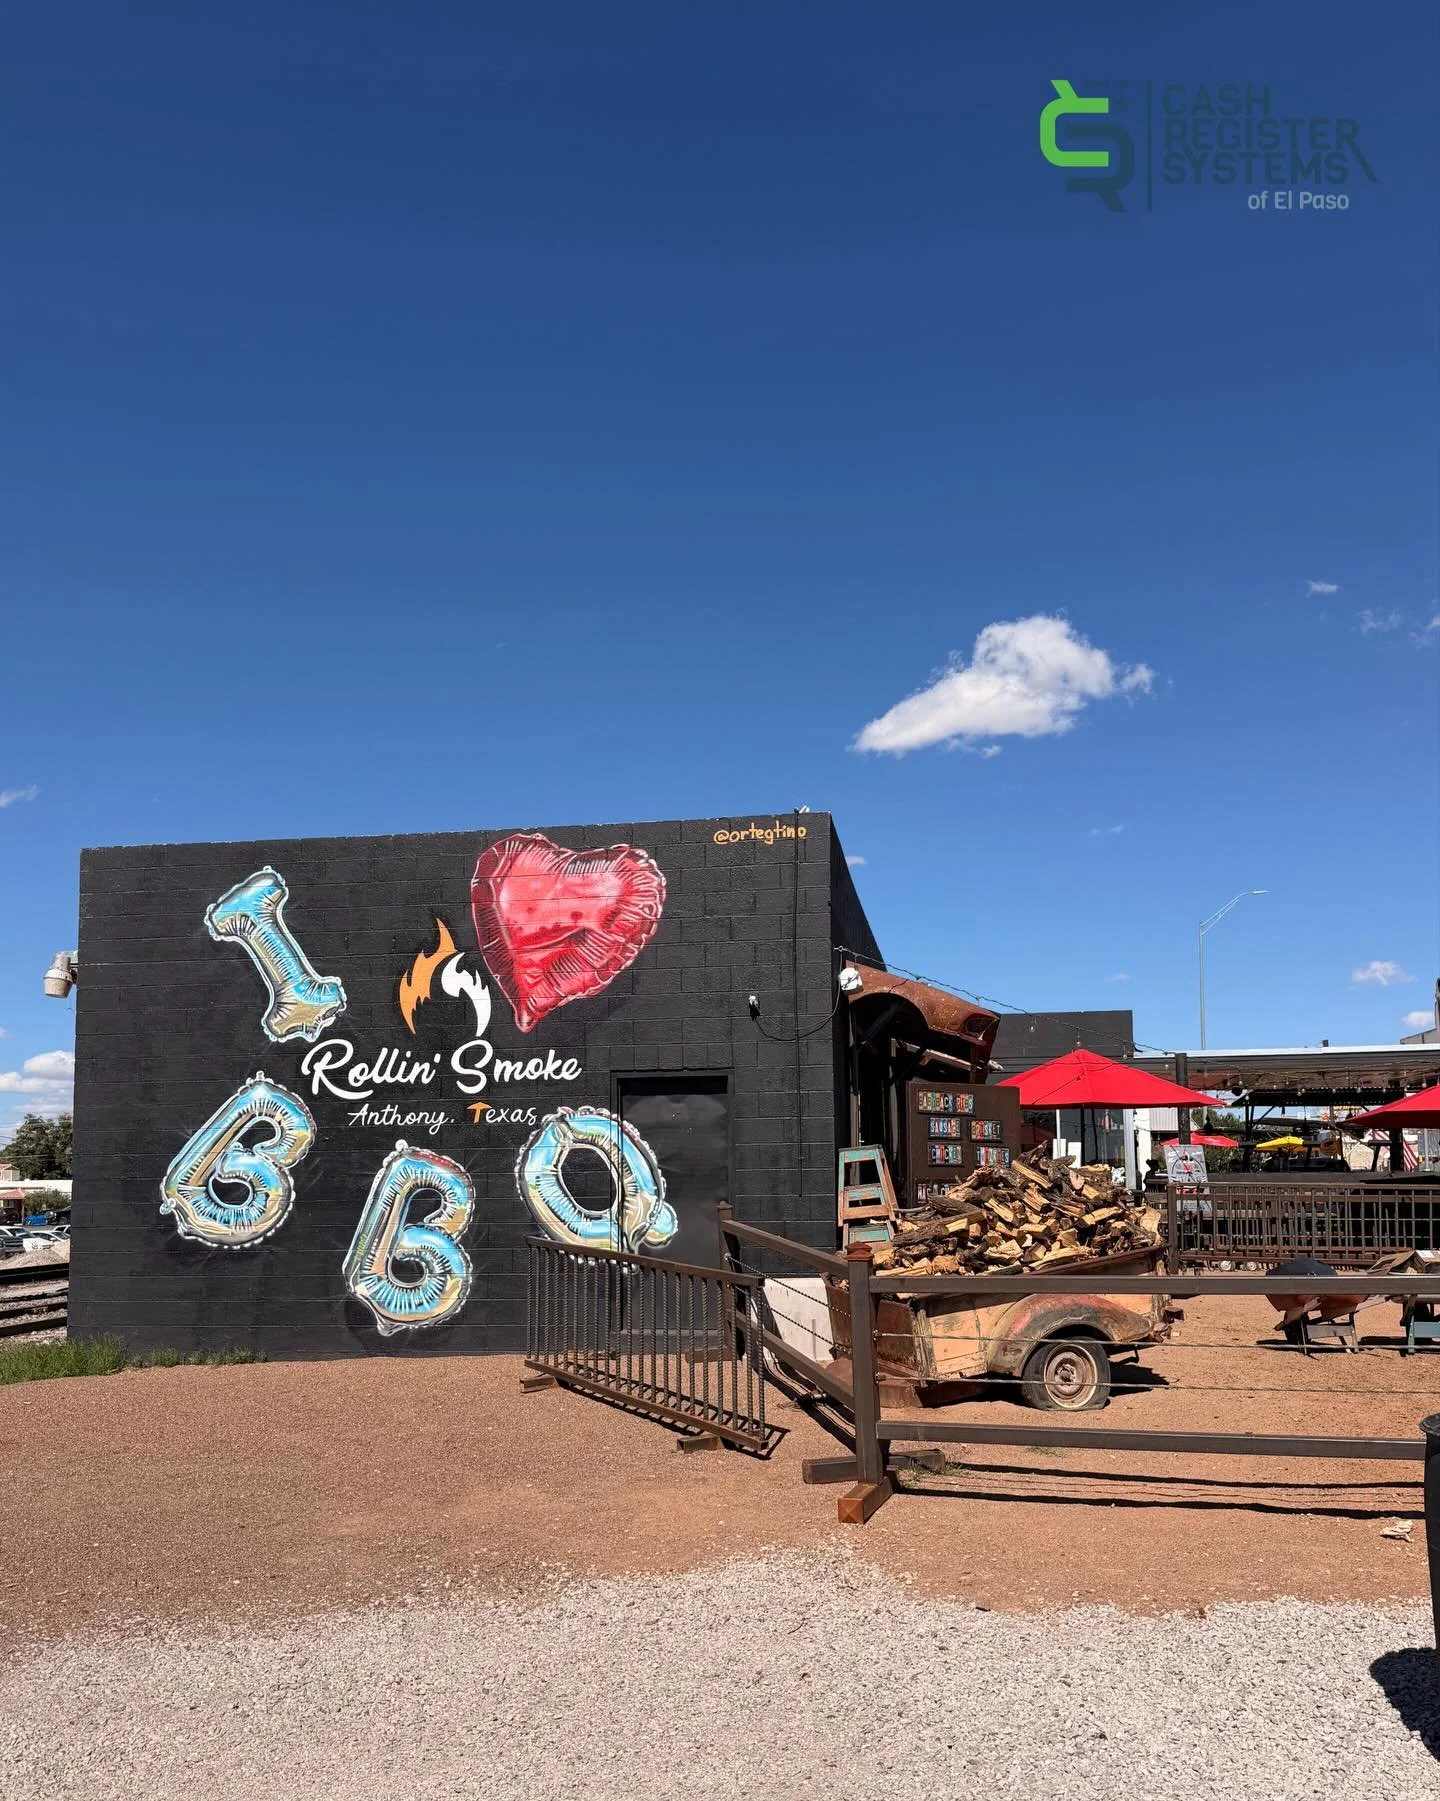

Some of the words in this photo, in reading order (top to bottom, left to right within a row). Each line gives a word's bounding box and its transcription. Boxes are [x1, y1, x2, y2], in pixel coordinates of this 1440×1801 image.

[300, 1038, 441, 1100] Rollin'
[450, 1039, 583, 1094] Smoke
[467, 1101, 538, 1126] Texas
[930, 1119, 960, 1135] SAUSAGE
[971, 1122, 1001, 1138] BRISKET
